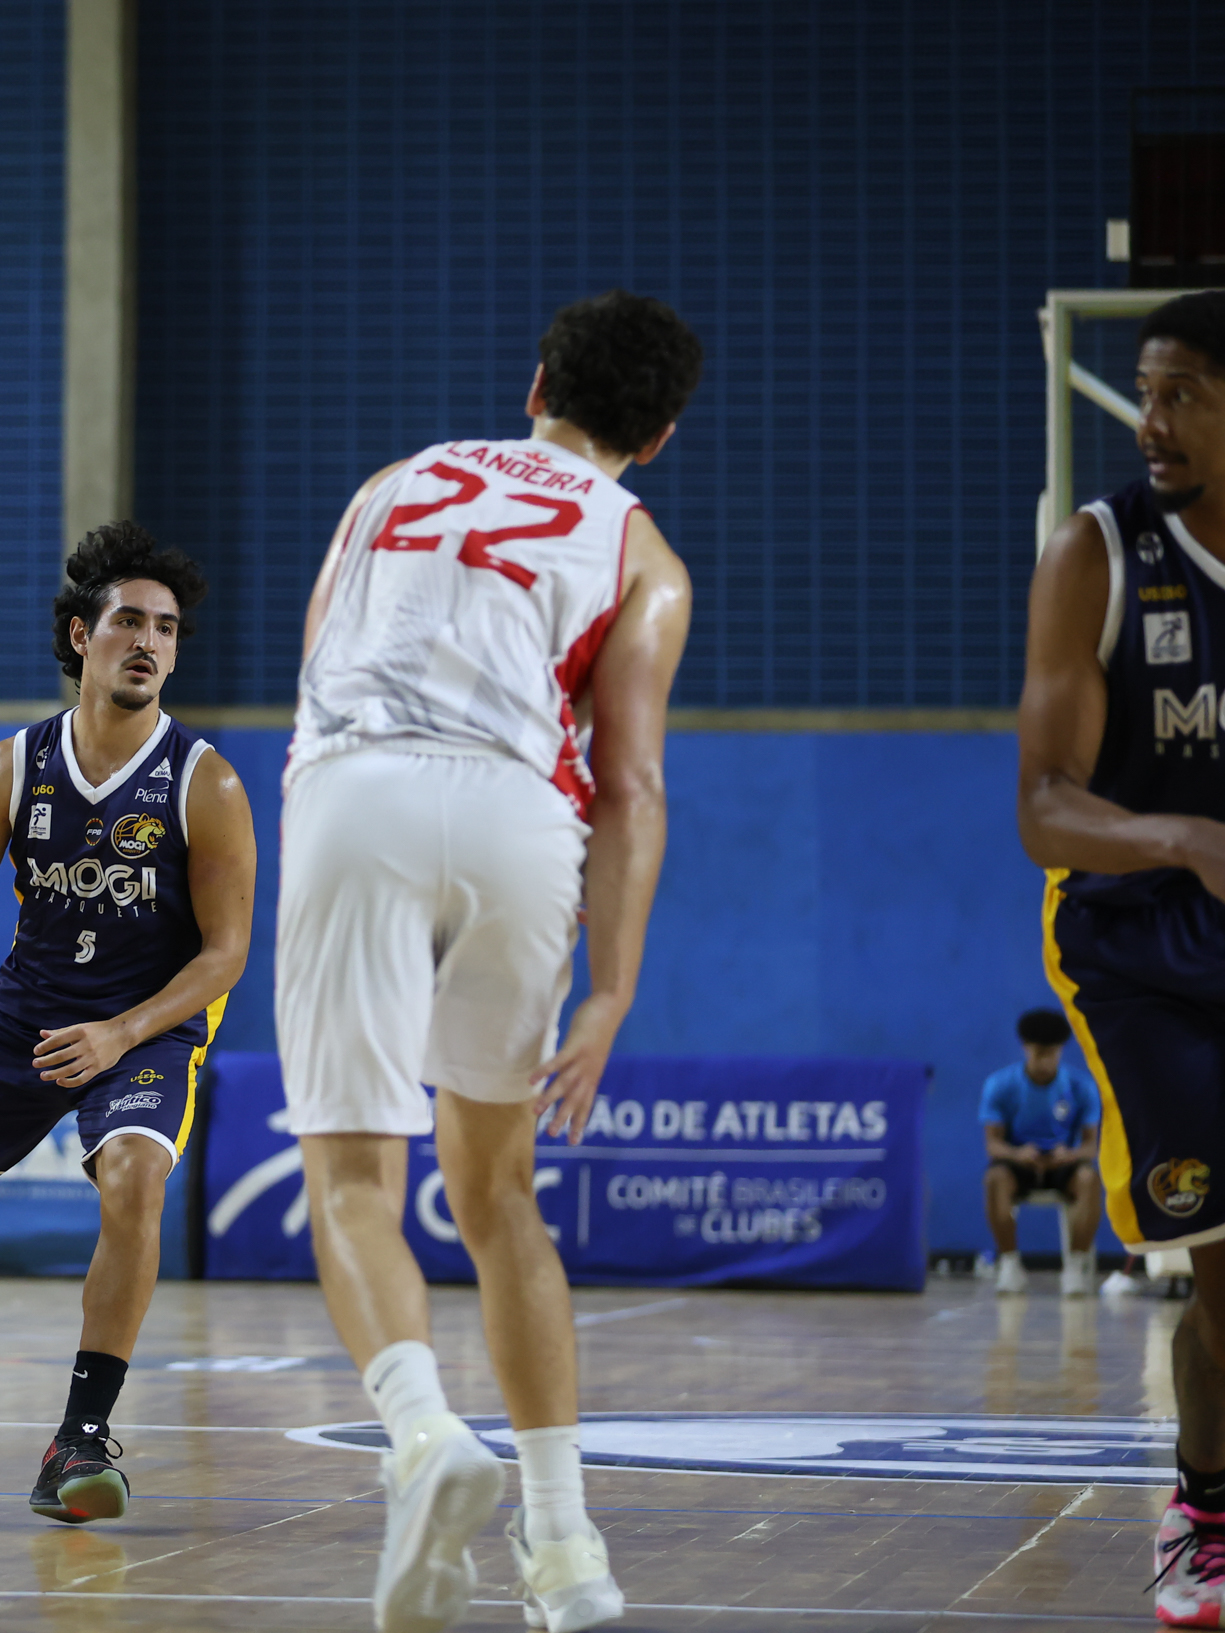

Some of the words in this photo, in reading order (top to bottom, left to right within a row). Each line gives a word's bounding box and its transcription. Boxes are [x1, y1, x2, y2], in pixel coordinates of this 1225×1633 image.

[446, 441, 595, 495] LANDEIRA
[370, 461, 584, 591] 22
[1153, 682, 1225, 740] M
[119, 839, 146, 851] MOGI
[27, 857, 156, 907] MOGI
[74, 930, 96, 963] 5
[651, 1100, 707, 1140] DE
[711, 1100, 888, 1142] ATLETAS
[606, 1171, 727, 1211] COMITÊ
[700, 1207, 822, 1243] CLUBES
